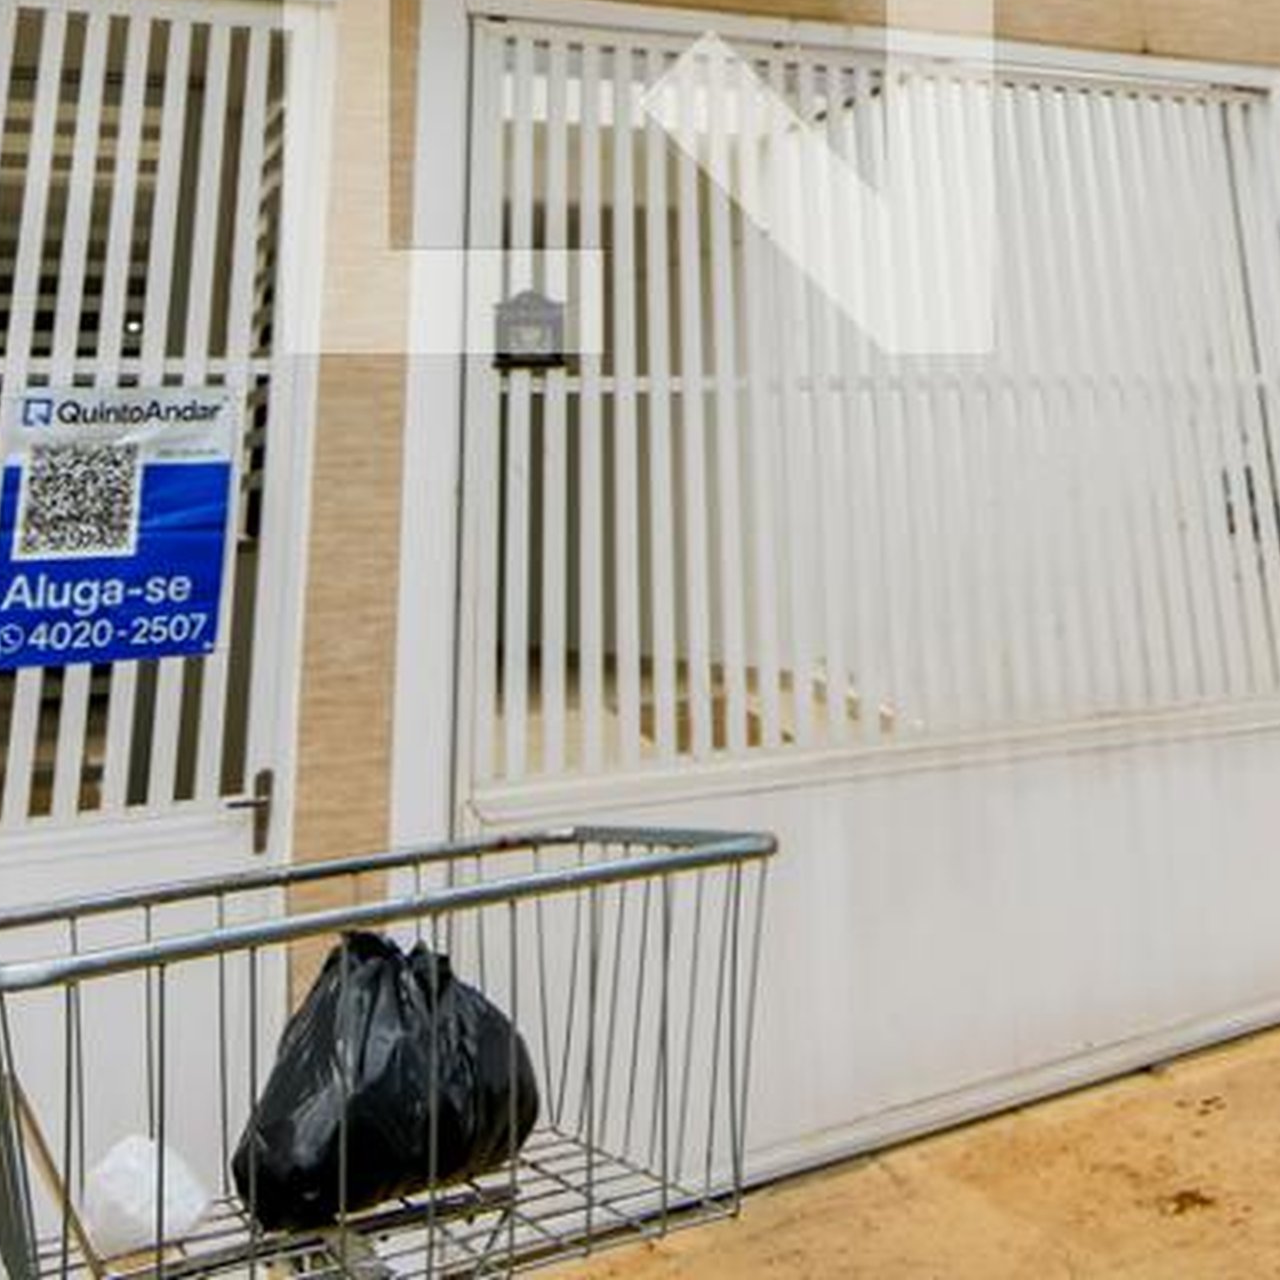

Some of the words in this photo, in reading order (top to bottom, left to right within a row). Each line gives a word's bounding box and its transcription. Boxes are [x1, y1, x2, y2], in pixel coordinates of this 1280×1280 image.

[56, 399, 223, 426] QuintoAndar
[0, 573, 192, 617] Aluga-se
[27, 612, 208, 651] 4020-2507
